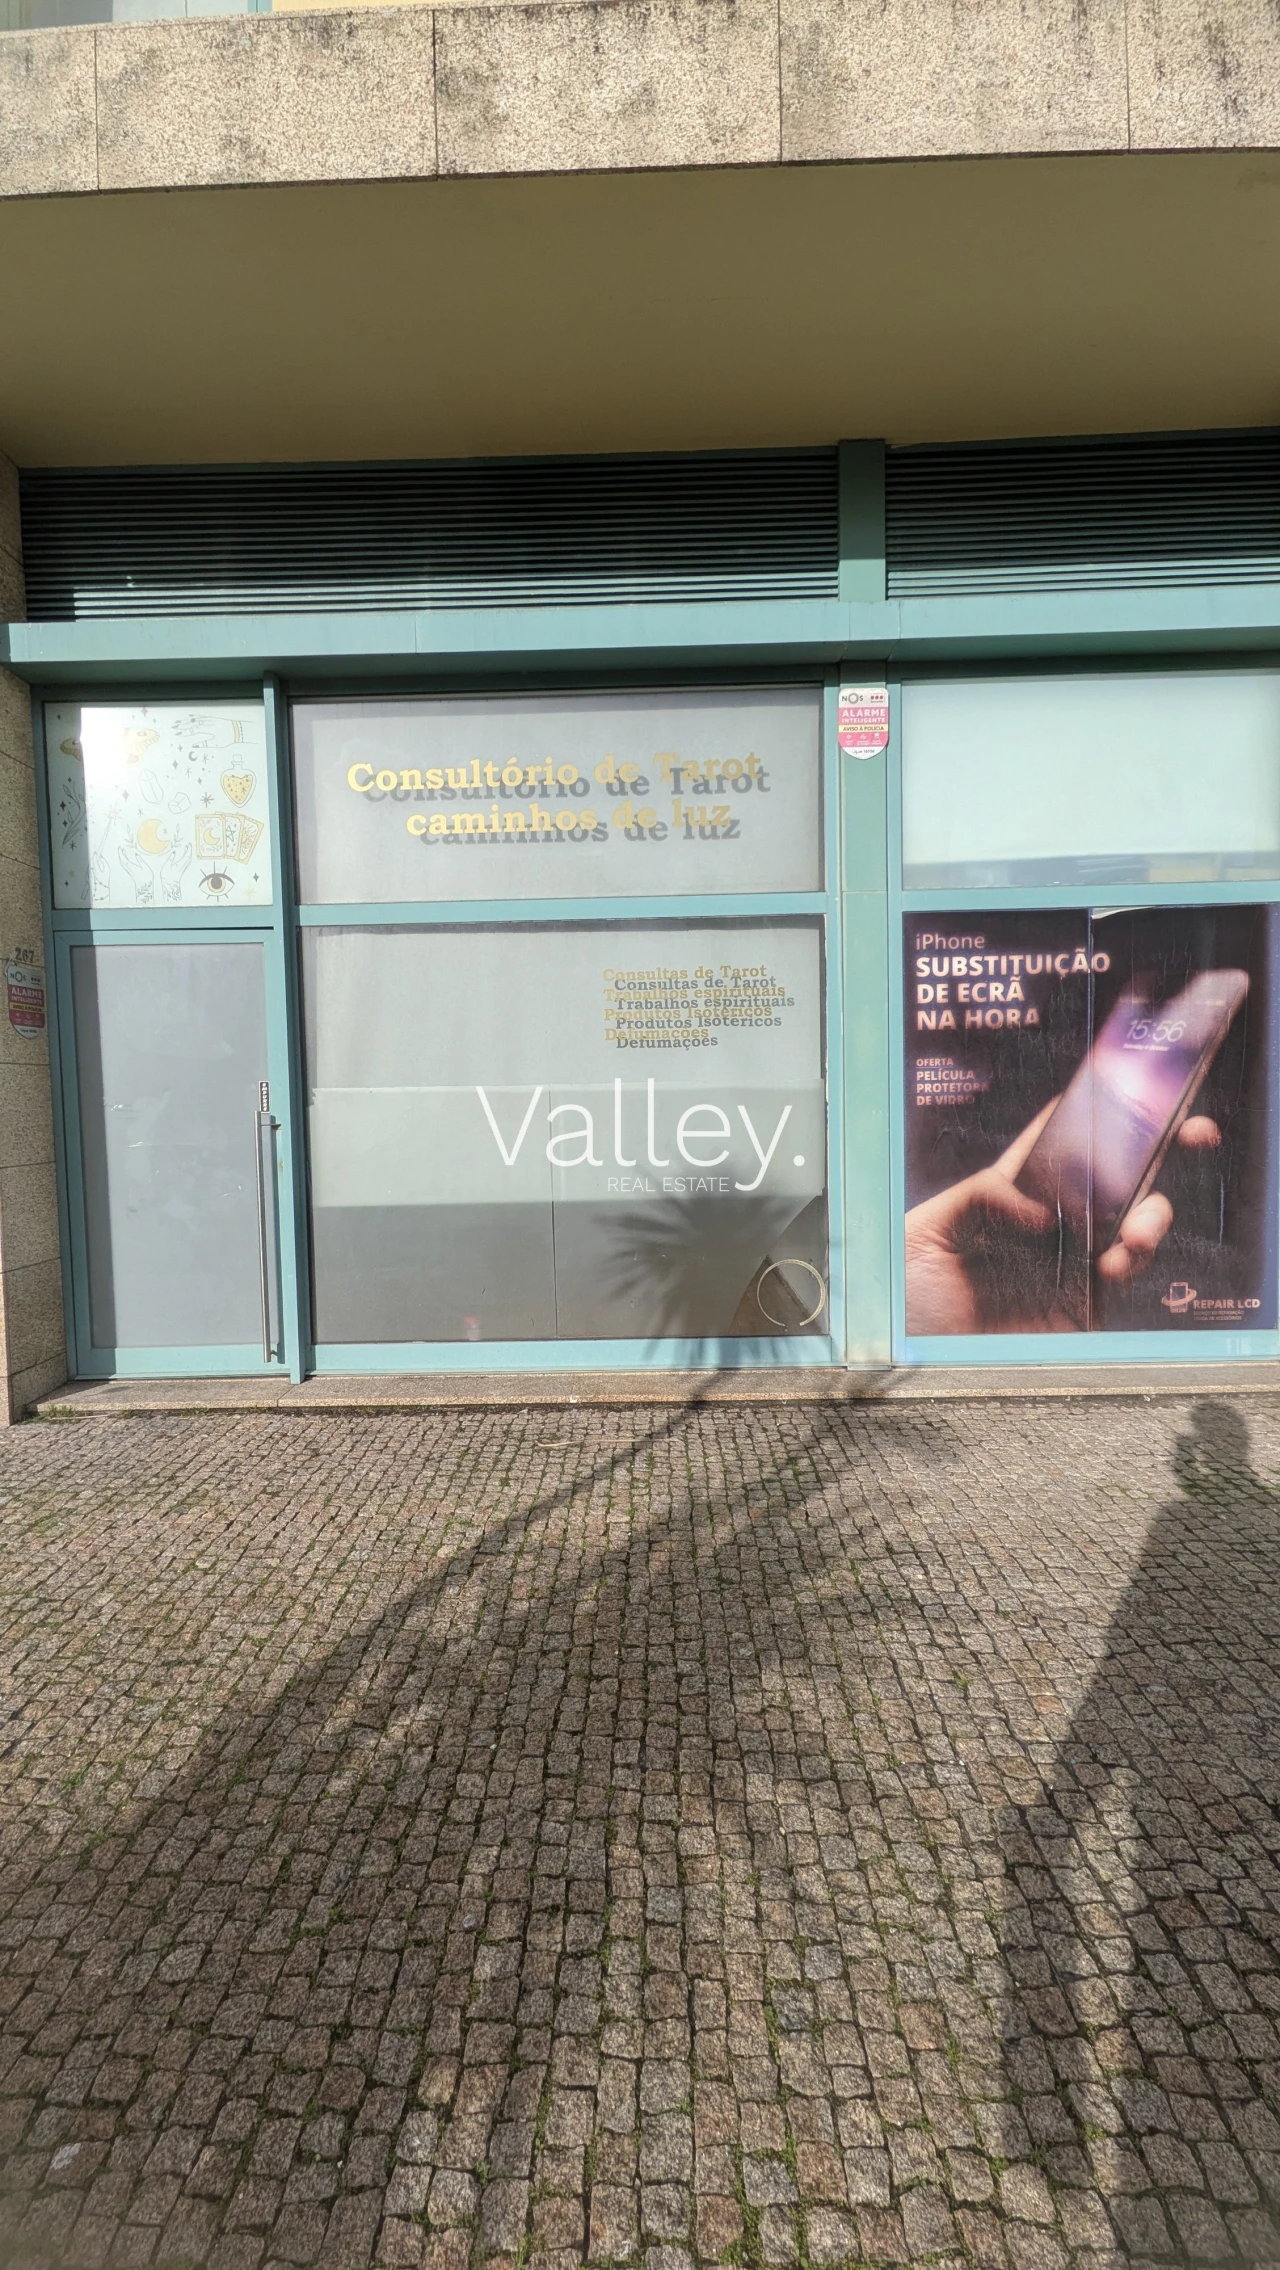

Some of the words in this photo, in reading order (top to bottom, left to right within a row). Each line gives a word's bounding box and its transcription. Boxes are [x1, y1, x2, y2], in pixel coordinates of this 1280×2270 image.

[841, 692, 864, 704] NOS
[842, 708, 886, 717] ALARME
[346, 756, 579, 793] Consultório
[594, 754, 640, 784] de
[652, 751, 763, 784] Tarot
[405, 802, 598, 837] caminhos
[612, 800, 658, 830] de
[671, 798, 733, 829] luz
[916, 933, 986, 950] iPhone
[916, 948, 1111, 980] SUBSTITUIÇÃO
[602, 966, 689, 982] Consultas
[694, 966, 714, 979] de
[720, 965, 767, 978] Tarot
[11, 986, 43, 999] ALARME
[603, 986, 688, 1001] Trabalhos
[694, 984, 786, 1000] espirituais
[917, 982, 949, 1005] DE
[957, 976, 1026, 1004] ECRÃ
[603, 1006, 681, 1021] Produtos
[916, 1010, 957, 1031] NA
[965, 1008, 1041, 1031] HORA
[1126, 1019, 1188, 1042] 15:56
[916, 1058, 954, 1067] OFERTA
[916, 1068, 976, 1081] PELÍCULA
[916, 1095, 932, 1106] DE
[935, 1095, 975, 1105] VIDRO
[1193, 1299, 1235, 1309] REPAIR
[1237, 1298, 1261, 1308] LCD
